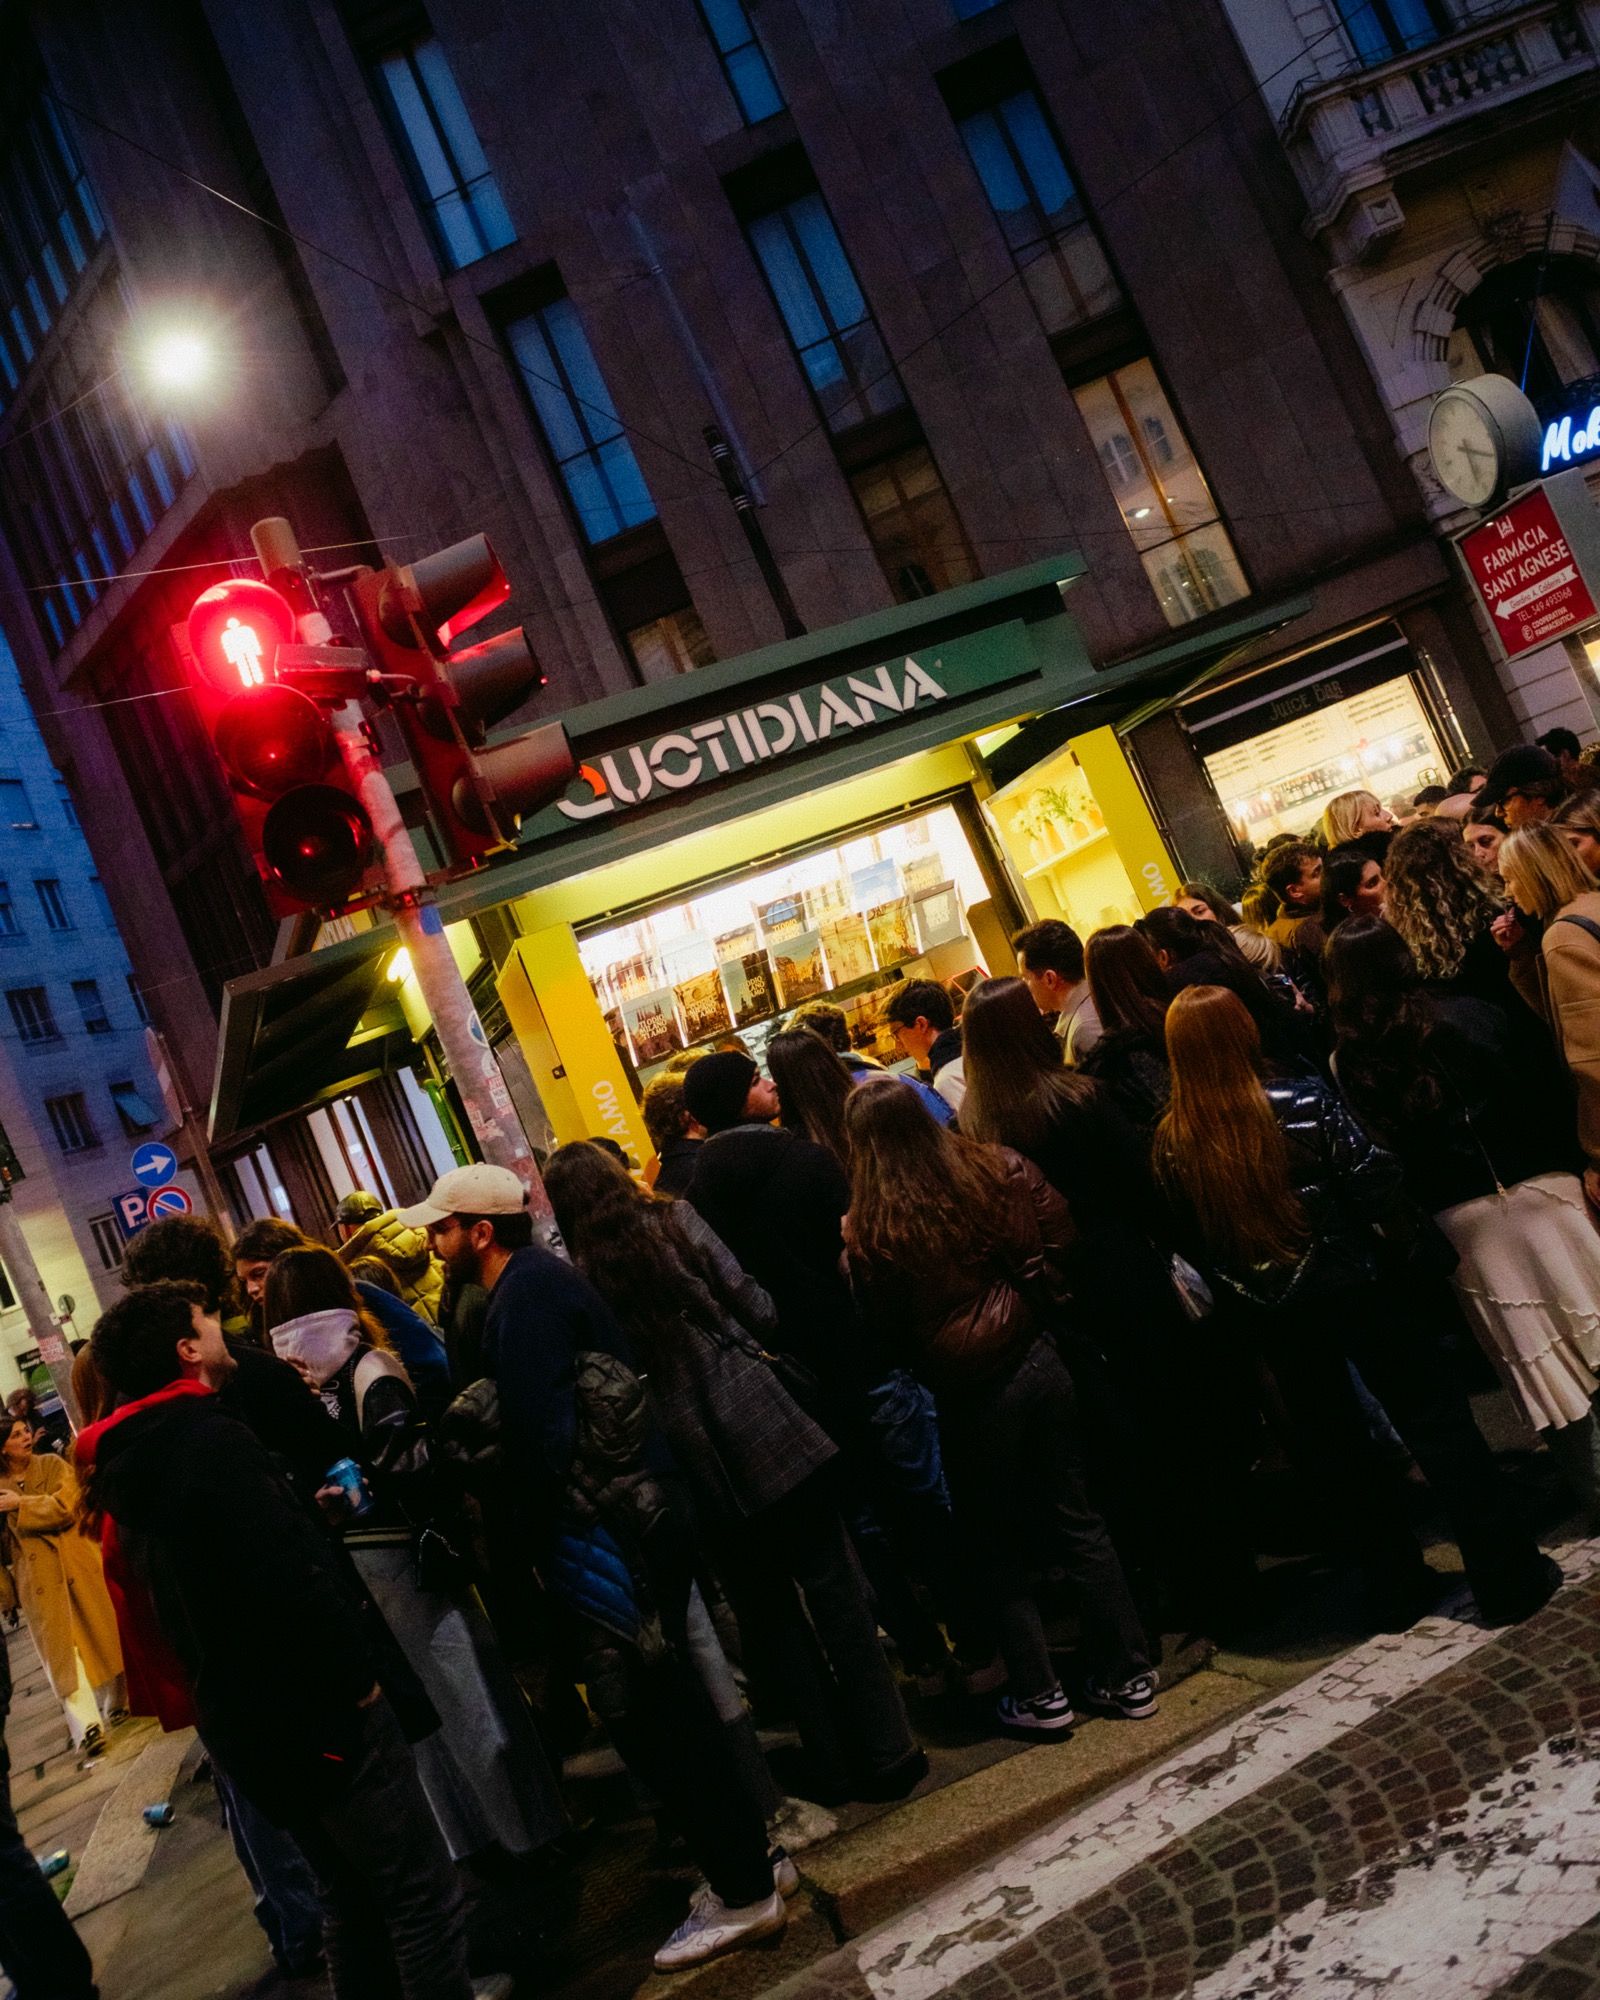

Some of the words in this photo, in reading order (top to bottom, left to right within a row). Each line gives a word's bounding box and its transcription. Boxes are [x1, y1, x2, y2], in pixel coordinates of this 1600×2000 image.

[1482, 525, 1549, 574] FARMACIA
[1483, 538, 1570, 600] SANT'AGNESE
[1530, 606, 1568, 629] COOPERATIVA
[1533, 611, 1575, 637] FARMACEUTICA
[638, 1019, 667, 1034] MILANO
[642, 1032, 650, 1040] TI
[649, 1025, 667, 1037] AMO
[645, 1014, 664, 1025] ODIO
[591, 1080, 631, 1136] AMO
[120, 1197, 145, 1228] P
